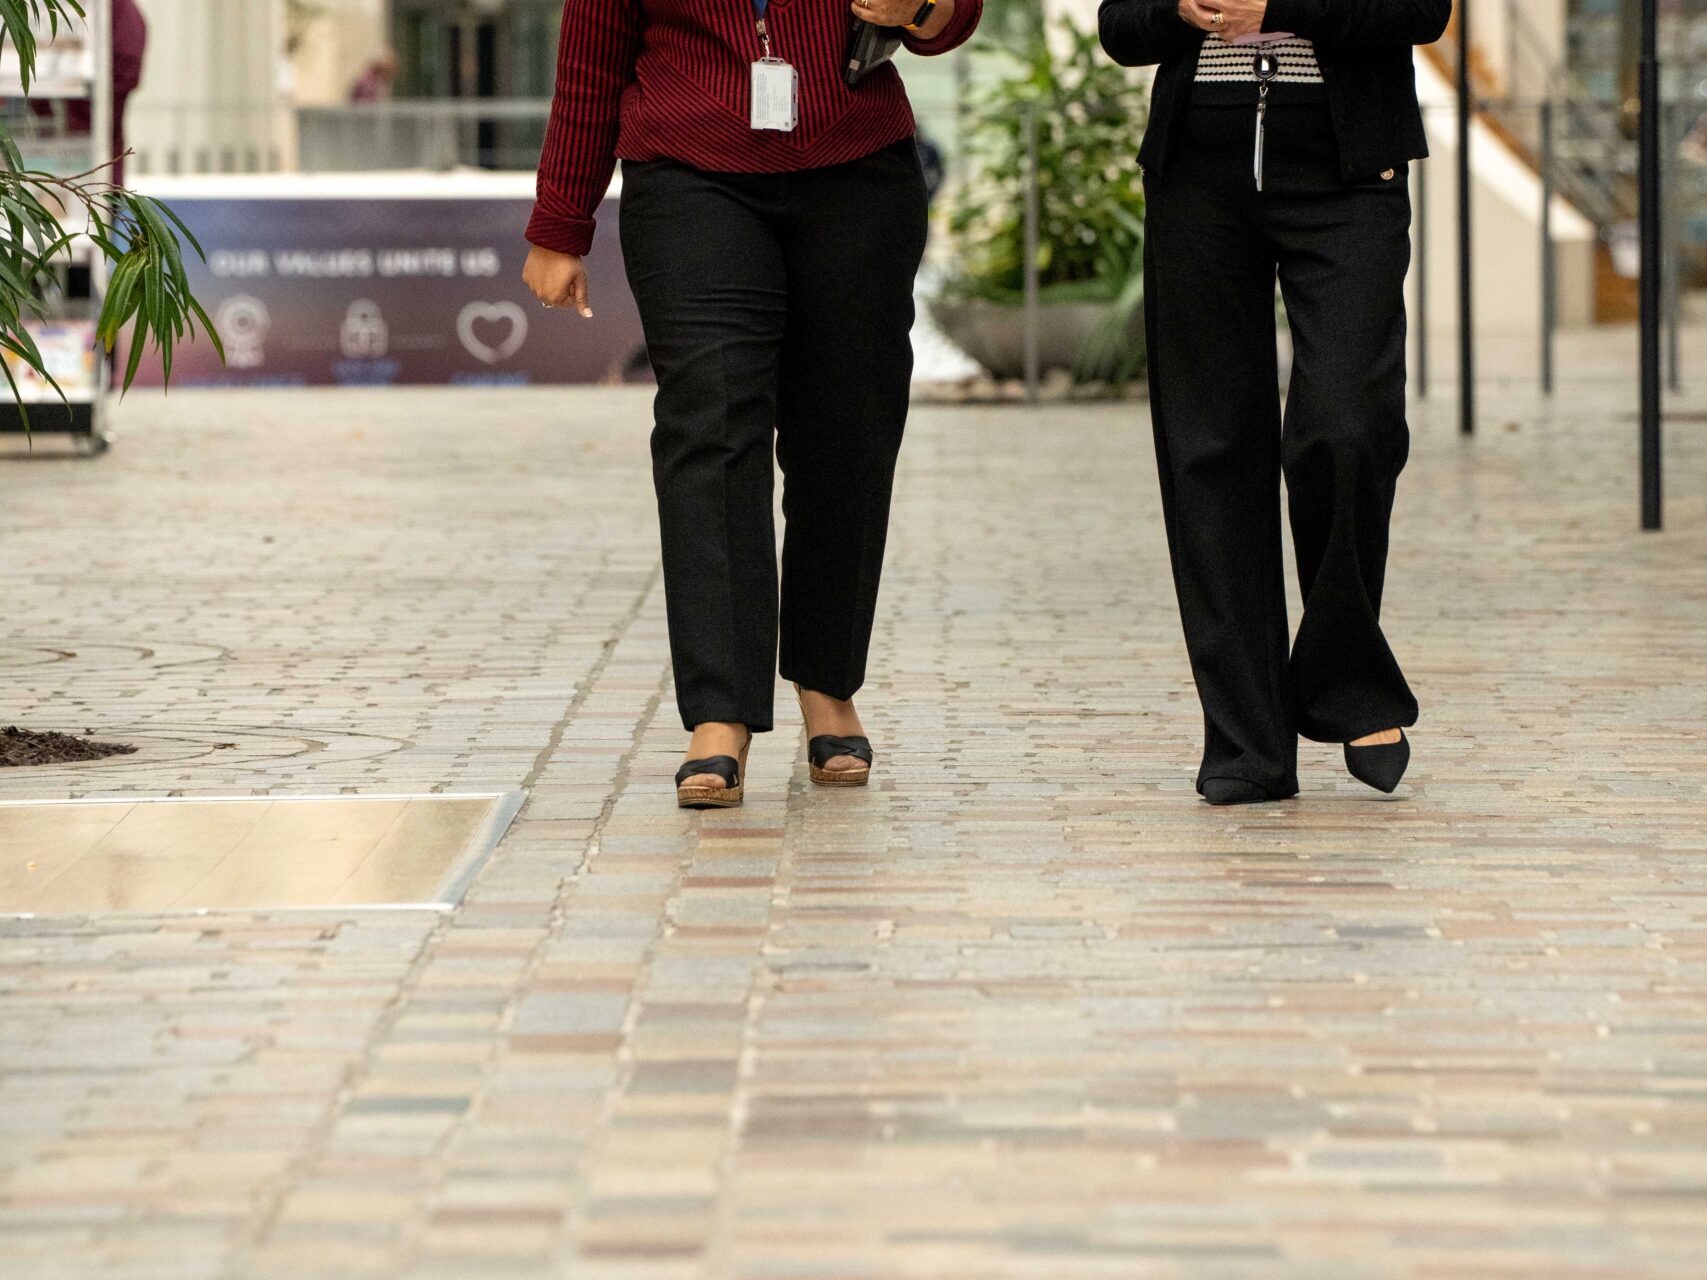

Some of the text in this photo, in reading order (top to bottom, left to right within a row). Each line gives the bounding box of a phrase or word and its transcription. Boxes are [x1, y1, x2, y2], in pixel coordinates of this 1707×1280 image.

[209, 246, 500, 278] OUR VALUES UNITE US
